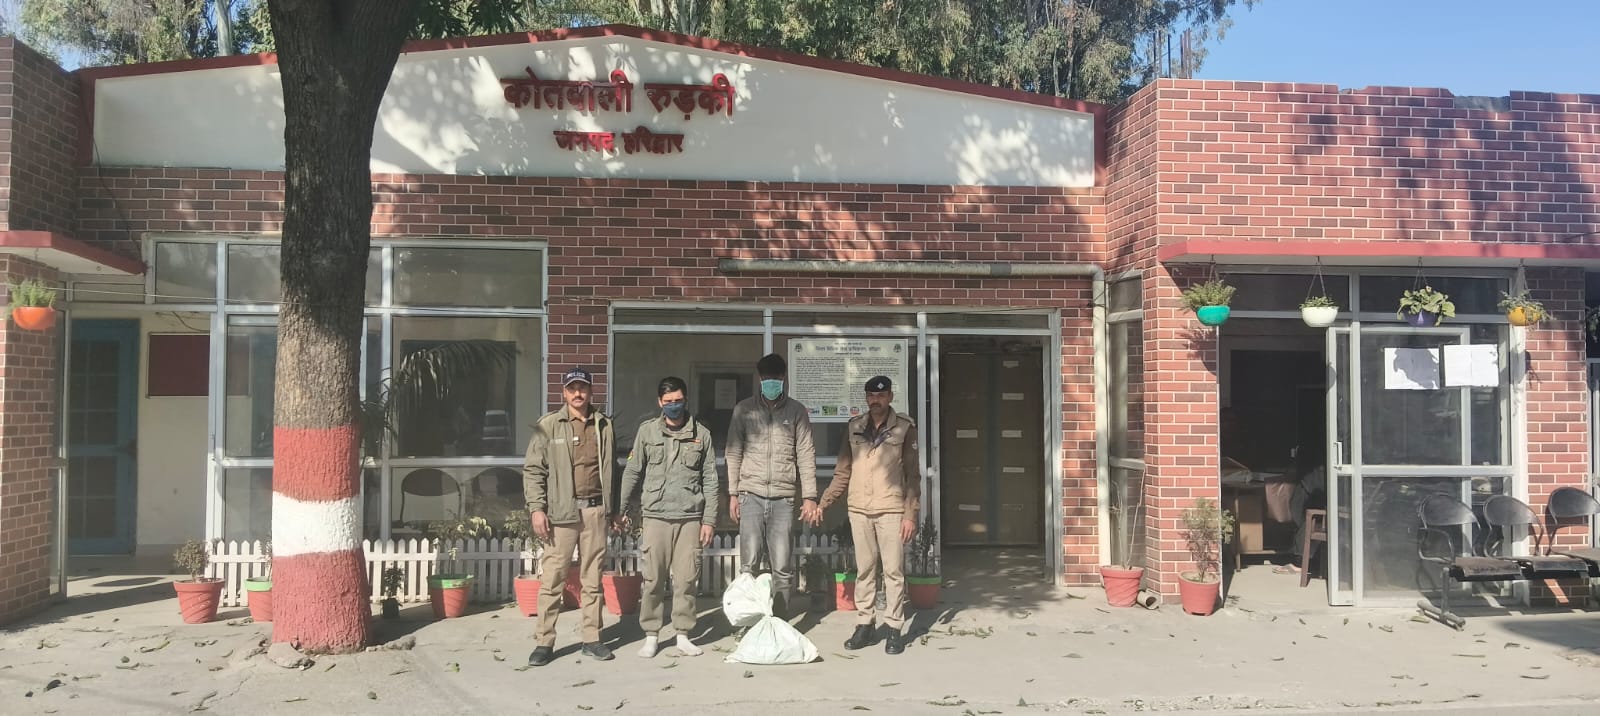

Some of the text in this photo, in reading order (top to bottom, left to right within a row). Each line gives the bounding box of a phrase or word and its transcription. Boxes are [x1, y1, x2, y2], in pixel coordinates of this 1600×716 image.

[500, 66, 736, 121] कोतवाली रुड़की
[553, 126, 685, 155] जनपद हरिद्वार
